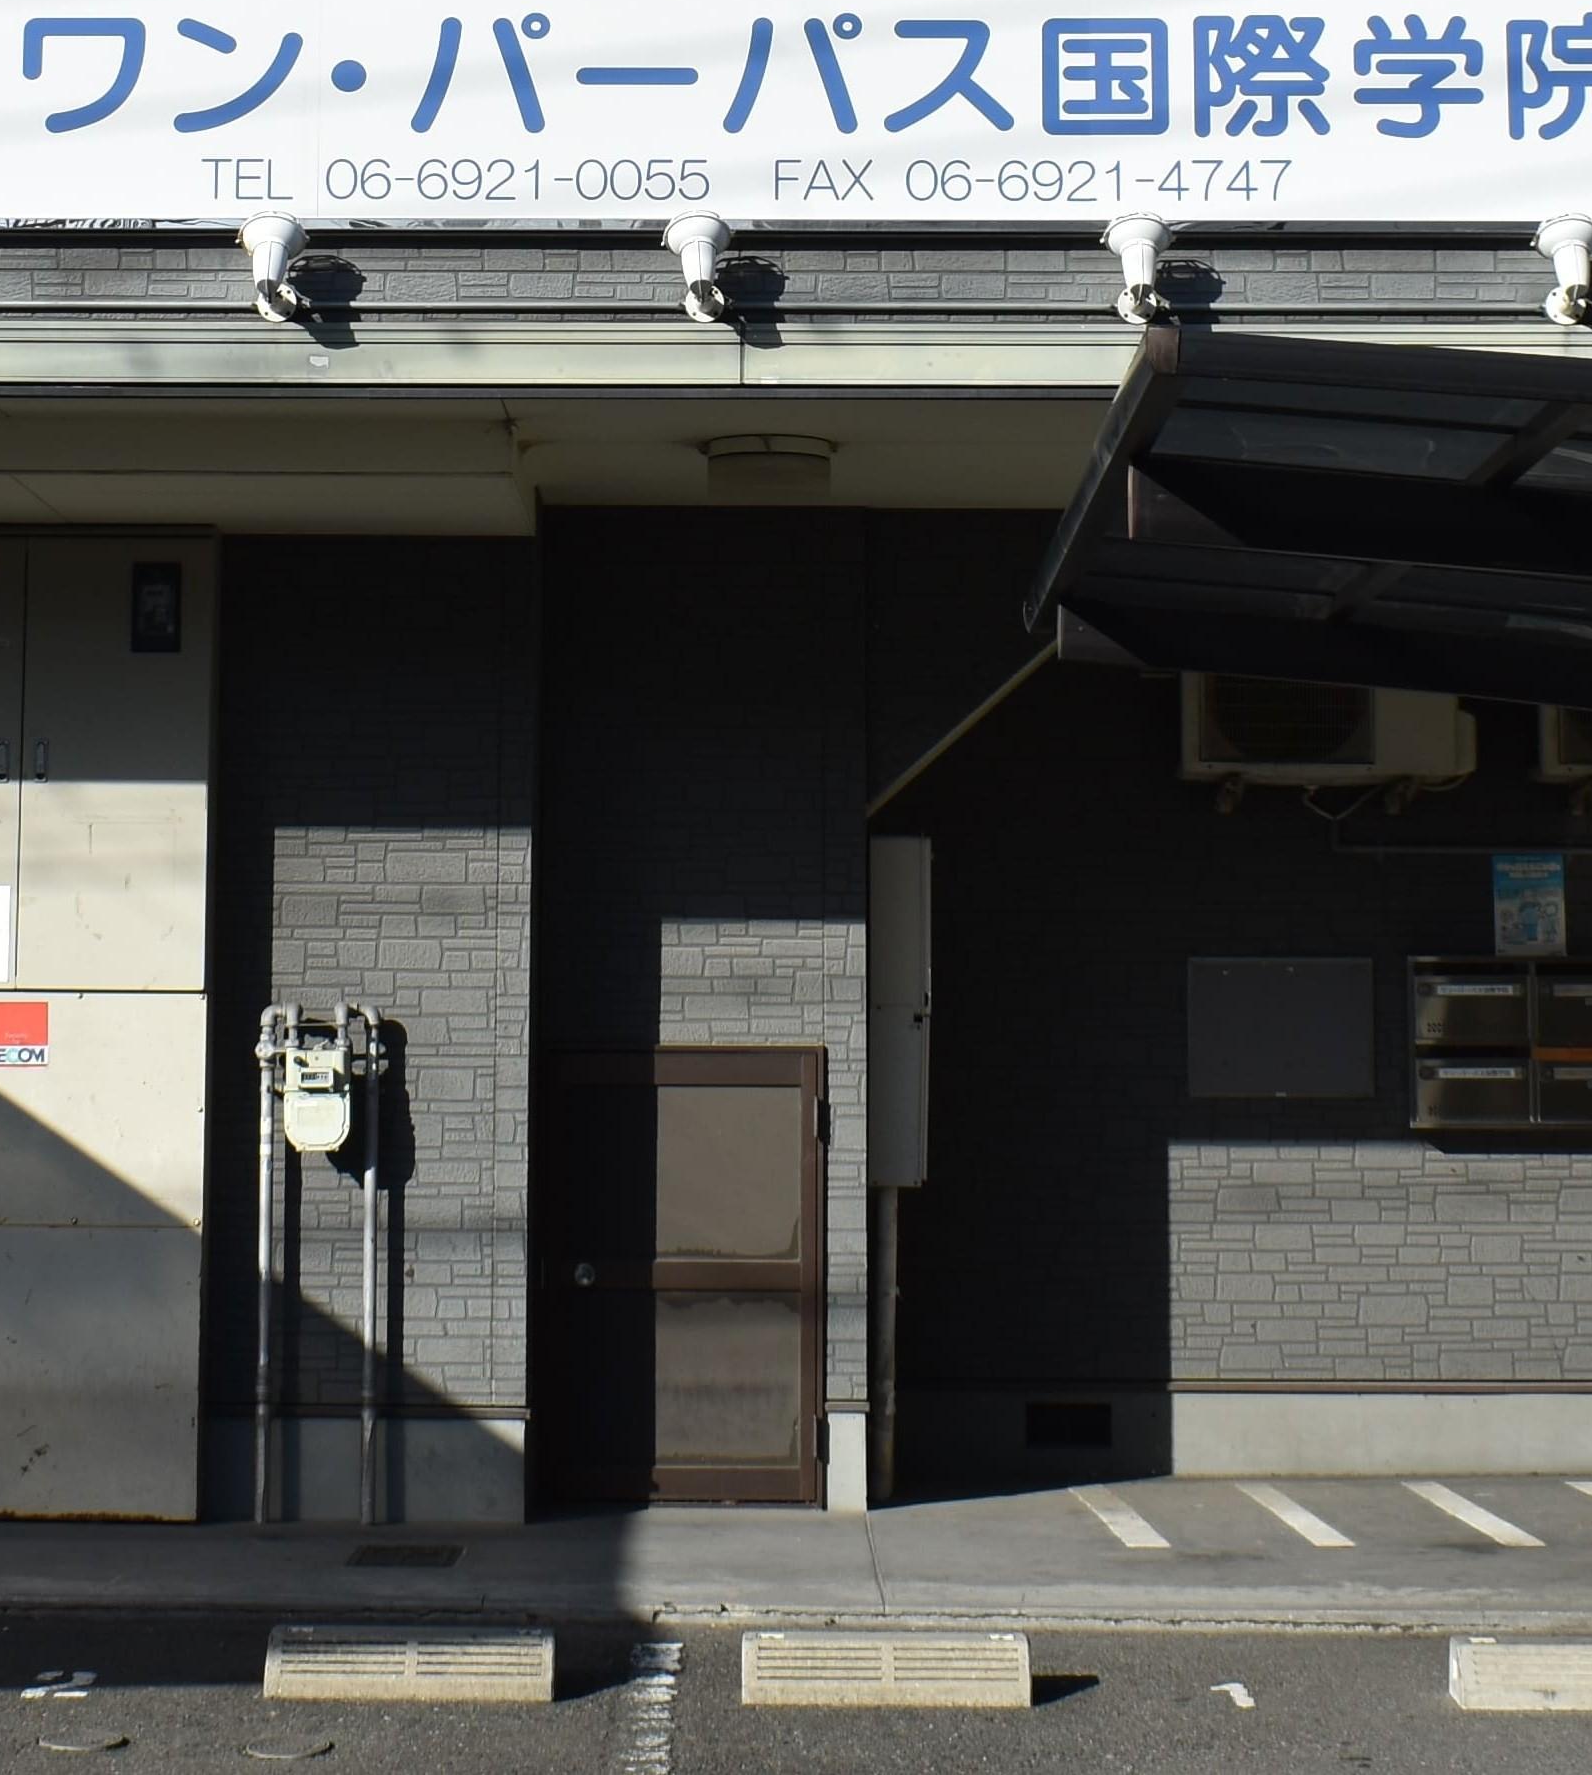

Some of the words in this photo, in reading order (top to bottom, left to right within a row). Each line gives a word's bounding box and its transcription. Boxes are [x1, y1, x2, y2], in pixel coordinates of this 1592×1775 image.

[201, 157, 294, 201] TEL
[325, 157, 710, 201] 06-6921-0055
[774, 157, 874, 201] FAX
[905, 157, 1293, 201] 06-6921-4747
